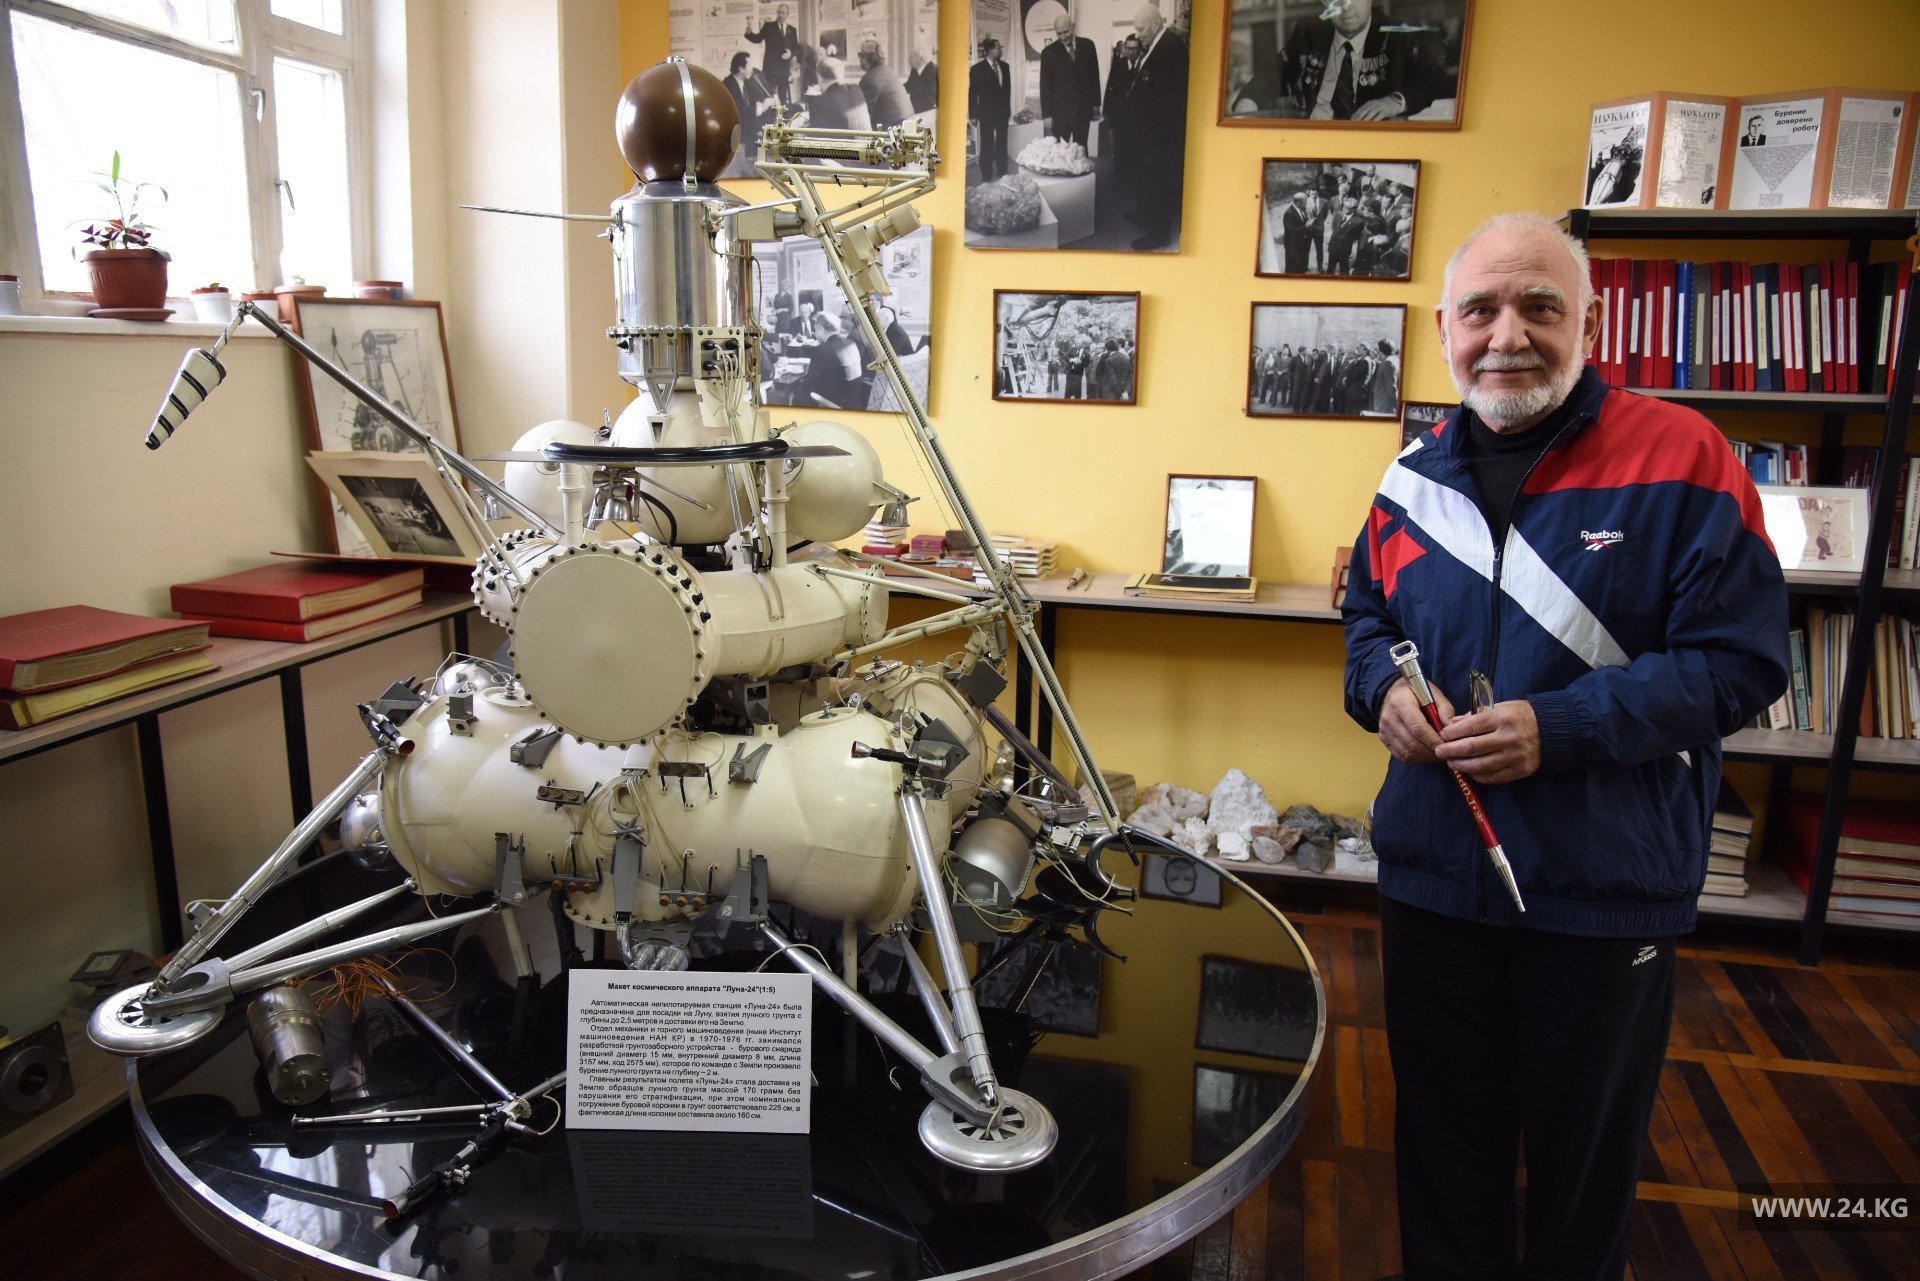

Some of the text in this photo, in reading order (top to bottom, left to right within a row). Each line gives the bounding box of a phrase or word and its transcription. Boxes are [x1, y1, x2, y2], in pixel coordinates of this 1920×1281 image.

[1774, 109, 1807, 118] Бурение
[1776, 117, 1813, 126] доверено
[1792, 124, 1819, 133] роботу
[1580, 530, 1624, 541] Reebok
[685, 985, 720, 993] аппарата
[590, 999, 648, 1007] Автоматическая
[650, 1001, 710, 1009] непилотируемая
[711, 1002, 741, 1010] станция
[580, 1008, 634, 1016] предназначена
[652, 1009, 681, 1017] посадки
[693, 1009, 714, 1018] Луну,
[741, 1011, 770, 1019] лунного
[580, 1015, 609, 1024] глубины
[632, 1017, 657, 1025] метров
[663, 1018, 696, 1026] доставки
[590, 1024, 612, 1032] Отдел
[656, 1026, 684, 1034] горного
[685, 1027, 744, 1035] машиноведения
[745, 1027, 767, 1035] (ныне
[768, 1027, 801, 1036] Институт
[579, 1033, 645, 1041] машиноведения
[670, 1034, 686, 1042] КР)
[699, 1034, 740, 1042] 1970-1976
[579, 1040, 624, 1049] разработкой
[625, 1041, 684, 1050] грунтозаборного
[685, 1042, 726, 1051] устройства
[737, 1044, 770, 1052] бурового
[771, 1045, 801, 1053] снаряда
[661, 1051, 674, 1059] мм,
[677, 1051, 719, 1060] внутренний
[738, 1060, 762, 1068] Земли
[763, 1062, 800, 1070] произвело
[579, 1065, 608, 1074] бурение
[609, 1067, 637, 1075] лунного
[671, 1067, 700, 1076] глубину
[622, 1076, 666, 1084] результатом
[607, 1083, 643, 1092] образцов
[681, 1085, 707, 1093] грунта
[641, 1092, 707, 1101] стратификации,
[707, 1094, 722, 1102] при
[578, 1100, 620, 1108] погружение
[620, 1100, 650, 1108] буровой
[686, 1102, 706, 1110] грунт
[578, 1107, 624, 1116] фактическая
[624, 1109, 647, 1117] длина
